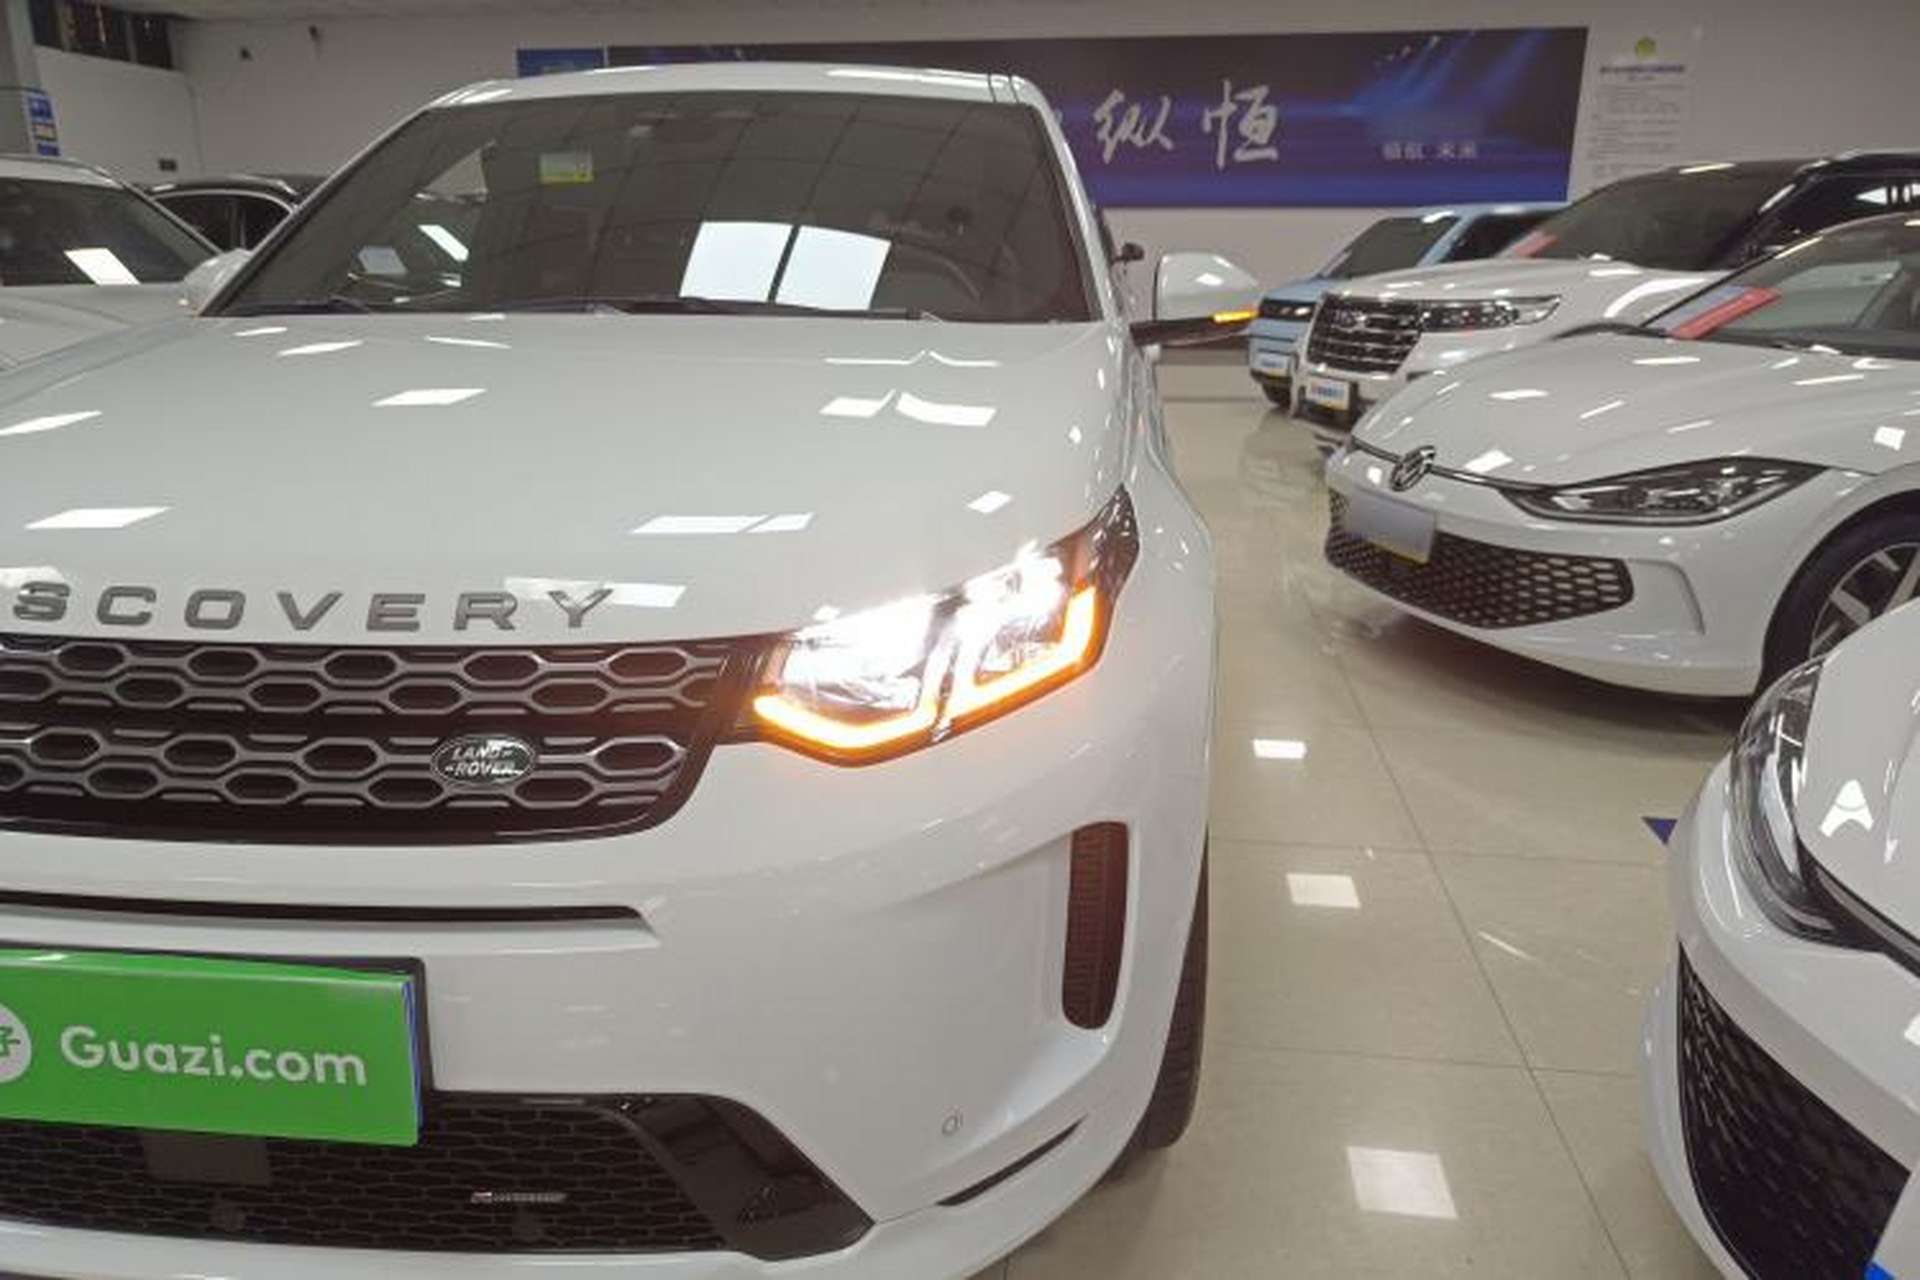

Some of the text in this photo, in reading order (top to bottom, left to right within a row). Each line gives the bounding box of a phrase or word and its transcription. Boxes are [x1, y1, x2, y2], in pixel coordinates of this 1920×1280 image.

[1055, 79, 1279, 170] 纵恒
[13, 581, 614, 633] SCOVERY
[60, 1025, 367, 1086] Guazi.com
